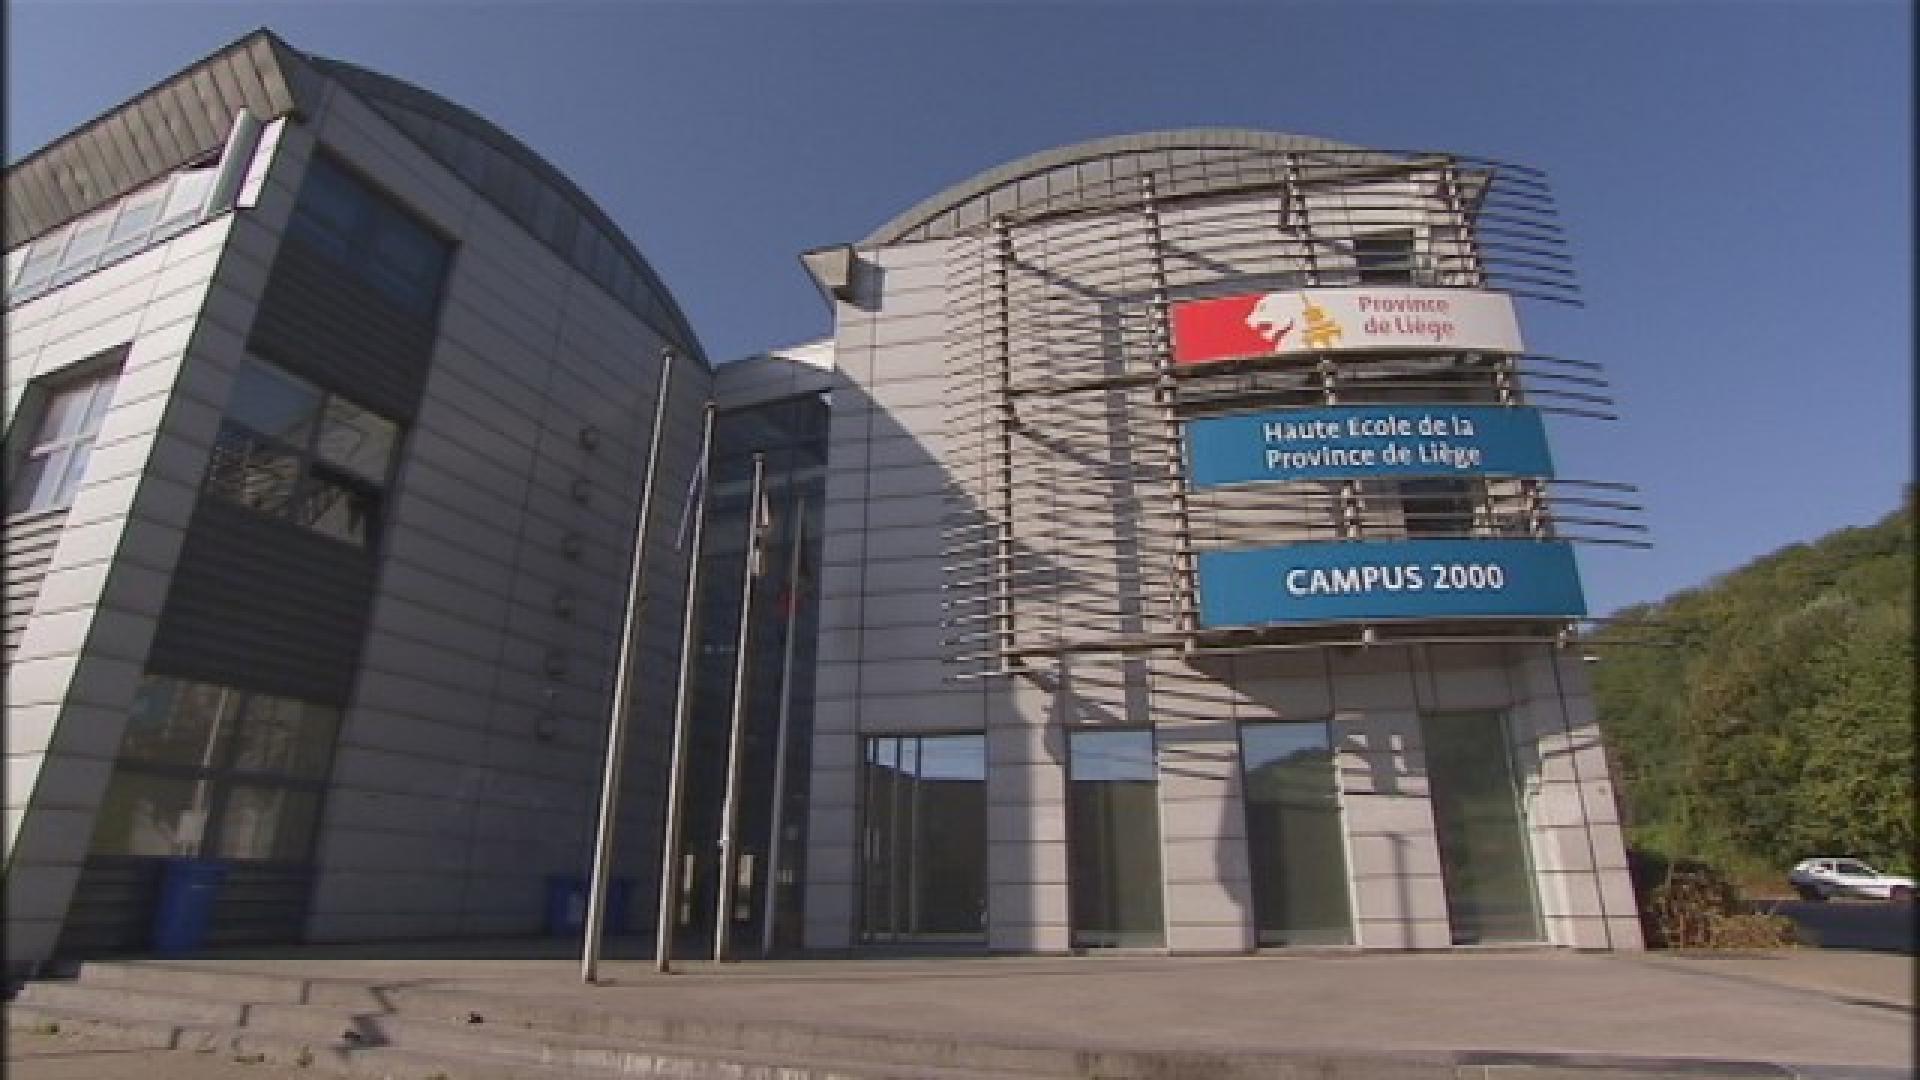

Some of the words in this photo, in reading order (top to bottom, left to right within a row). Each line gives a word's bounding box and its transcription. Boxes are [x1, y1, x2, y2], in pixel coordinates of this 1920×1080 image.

[1358, 295, 1450, 315] Province
[1364, 316, 1389, 336] de
[1263, 421, 1340, 442] Haute
[1418, 415, 1447, 436] de
[1452, 415, 1474, 436] la
[1267, 446, 1375, 469] Province
[1382, 445, 1412, 466] de
[1419, 444, 1481, 468] Liège
[1286, 566, 1423, 596] CAMPUS
[1431, 564, 1505, 590] 2000
